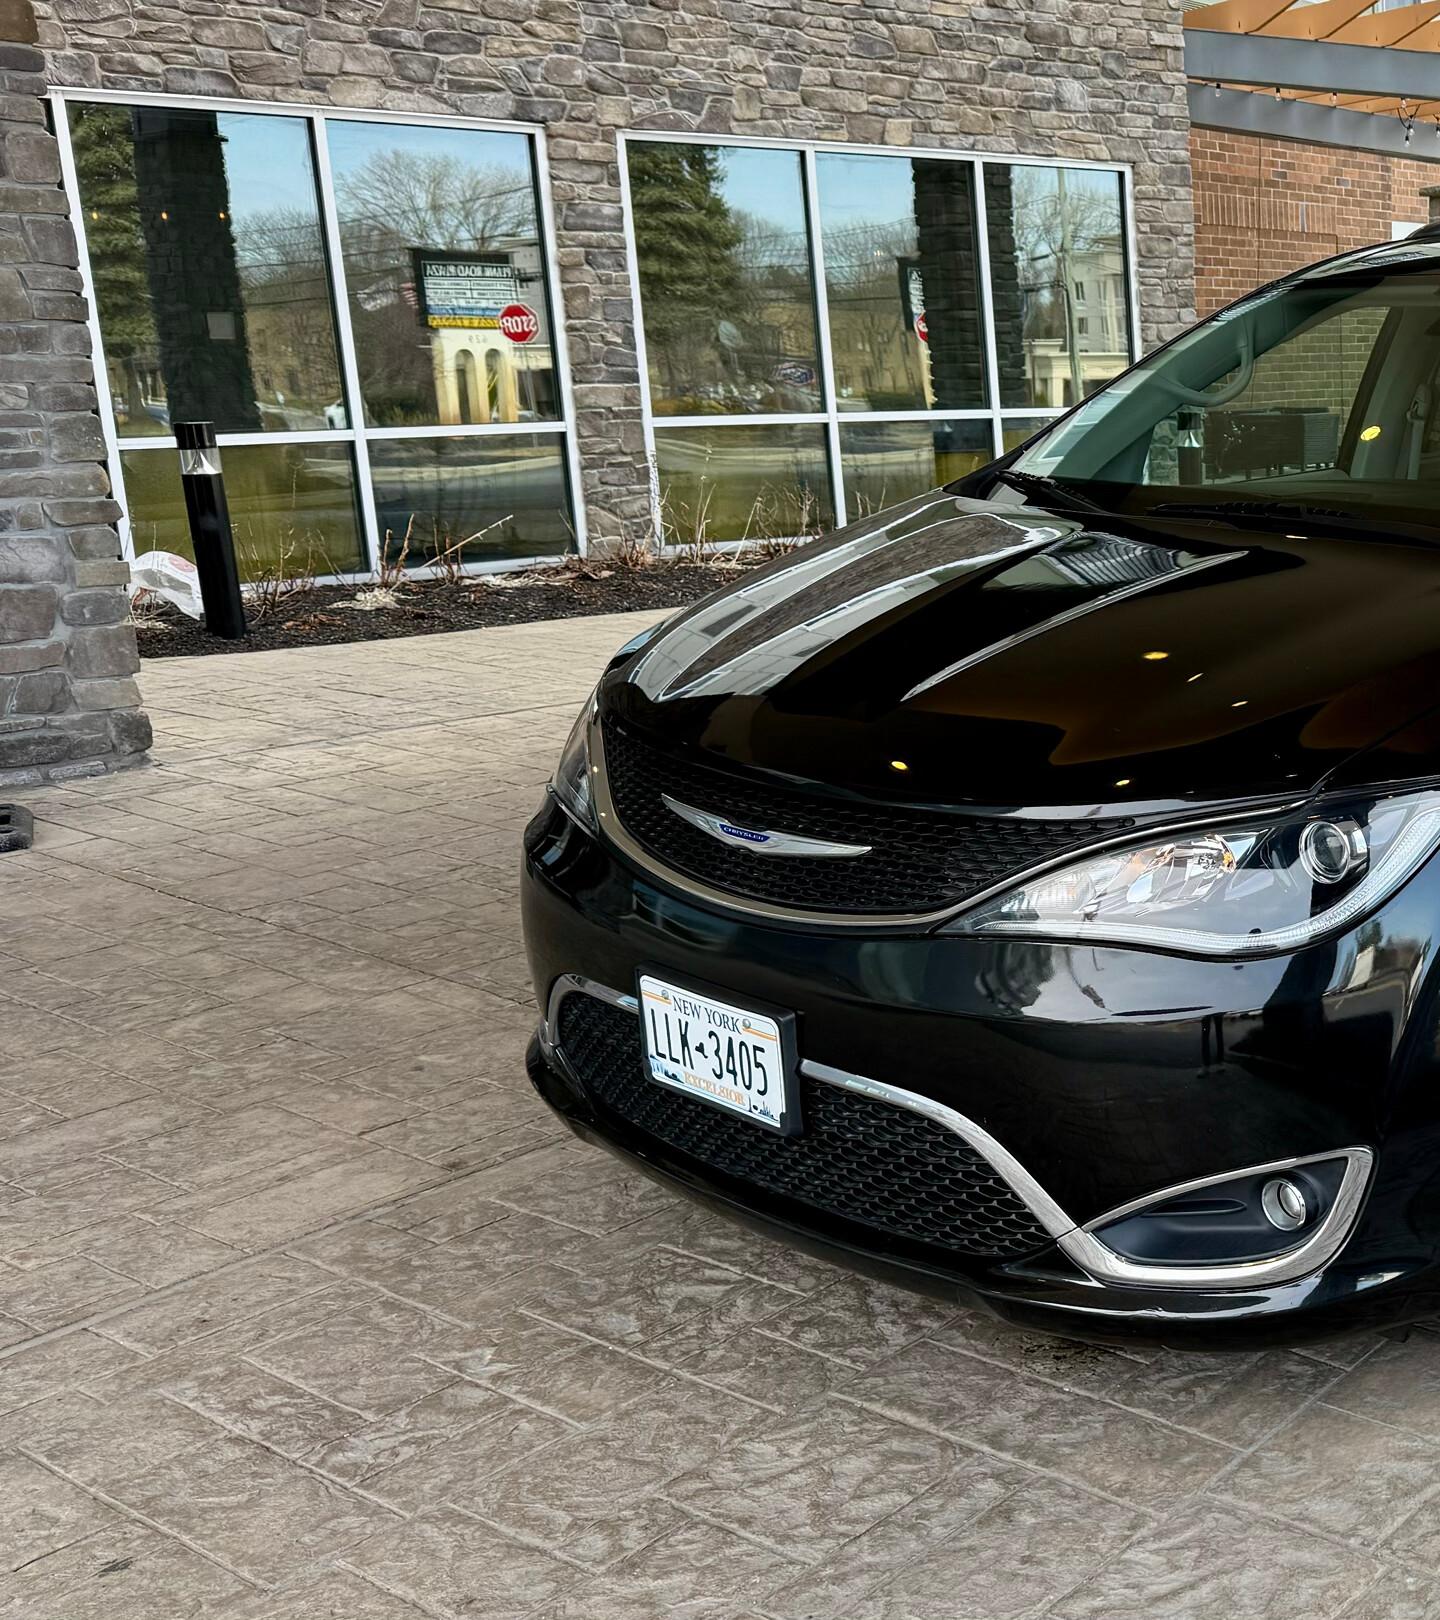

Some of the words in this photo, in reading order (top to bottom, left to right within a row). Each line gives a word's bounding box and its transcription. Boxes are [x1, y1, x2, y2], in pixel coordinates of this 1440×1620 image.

[723, 826, 764, 841] CHRYSLER
[673, 995, 702, 1018] NEW
[706, 1008, 742, 1035] YORK
[684, 1071, 745, 1106] EXCELSIOR
